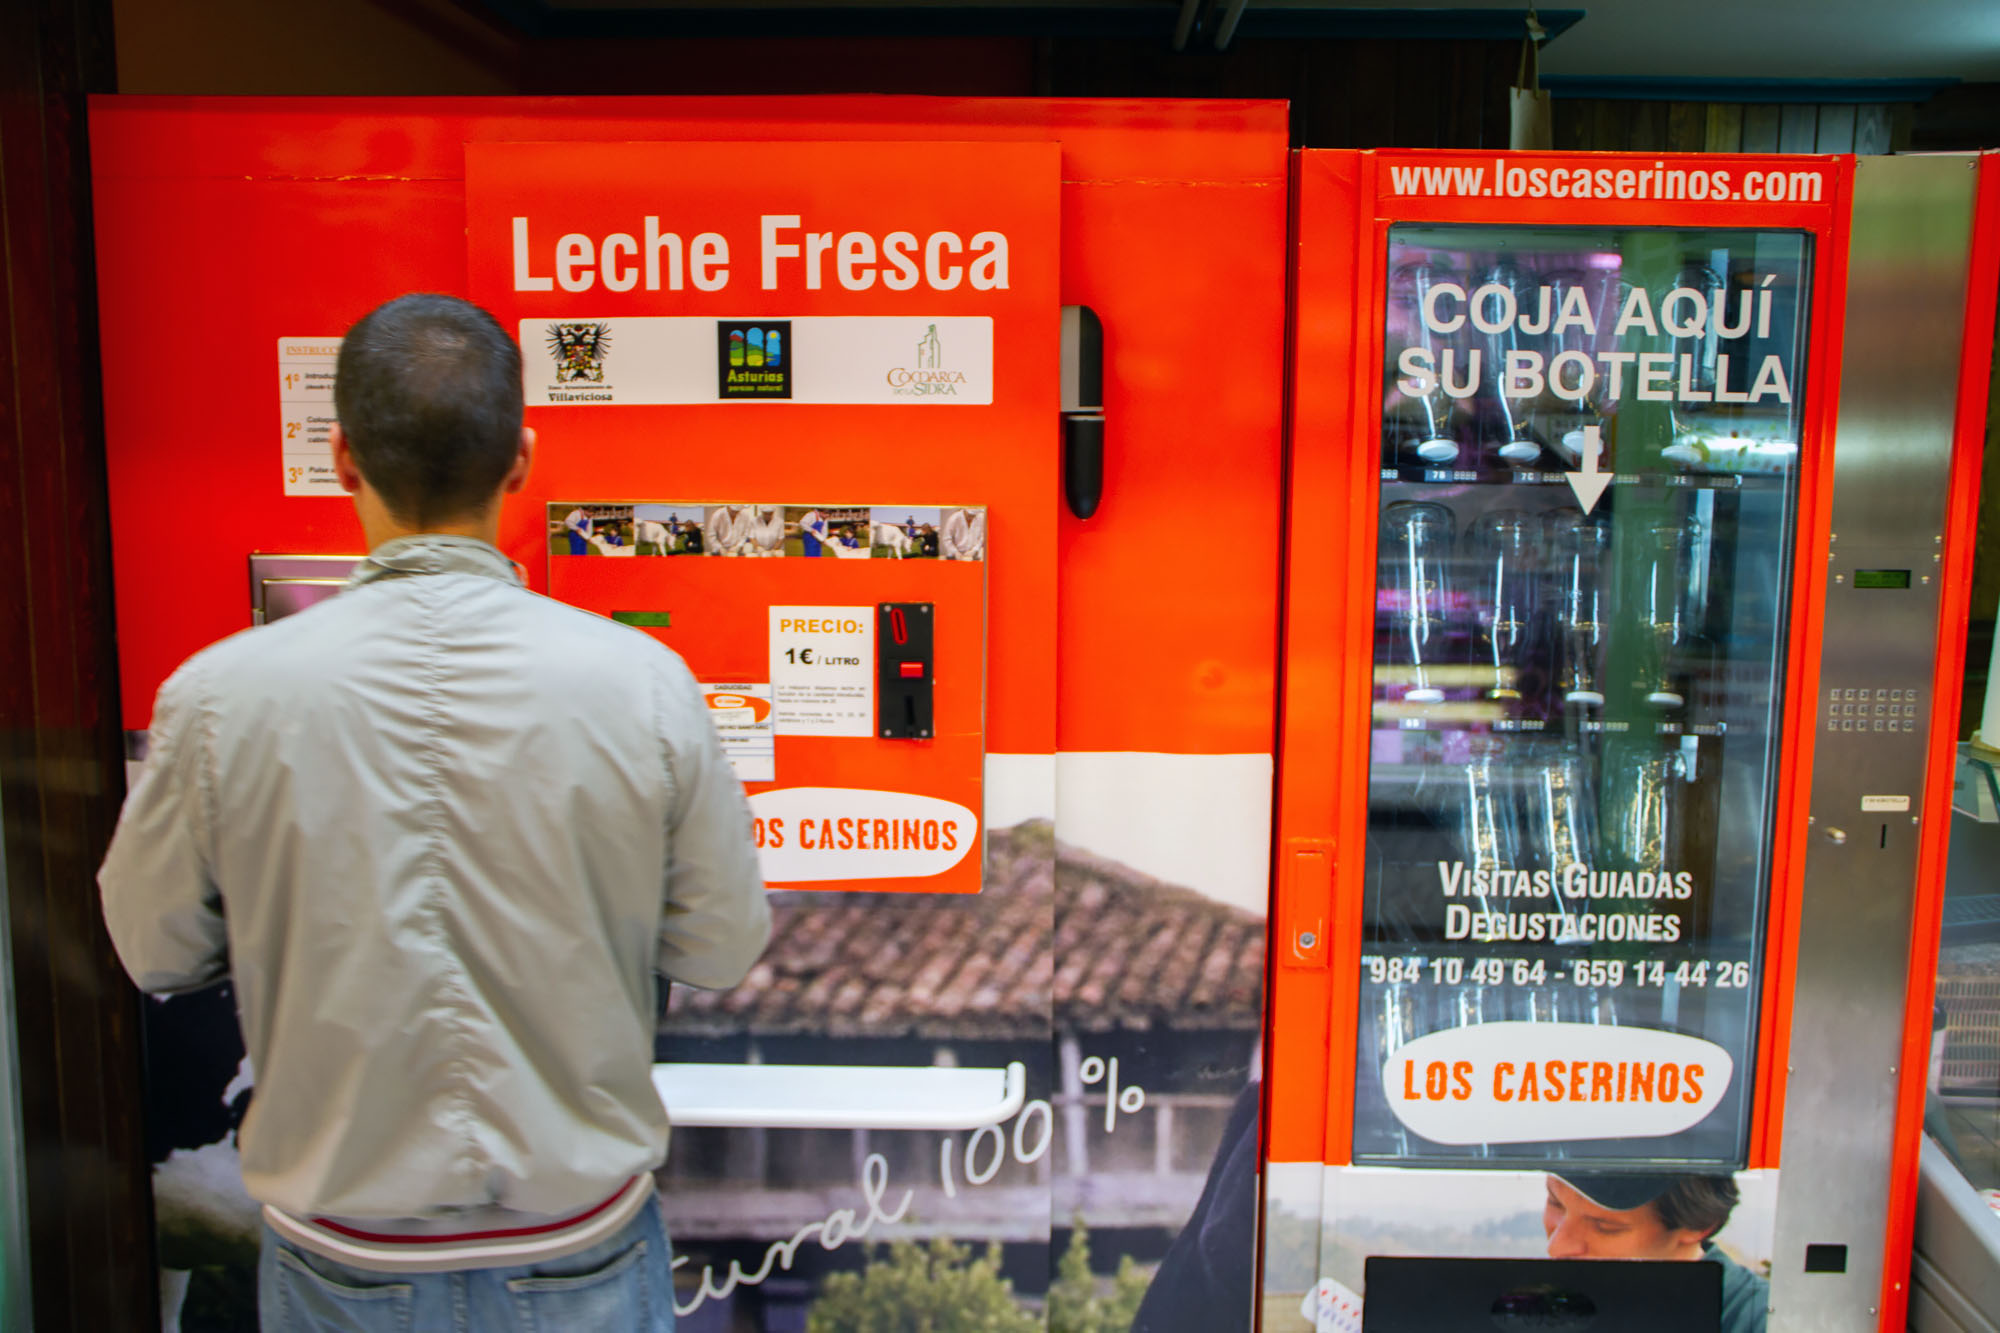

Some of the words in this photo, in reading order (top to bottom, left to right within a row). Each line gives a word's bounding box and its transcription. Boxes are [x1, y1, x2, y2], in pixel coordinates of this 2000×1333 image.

[1391, 158, 1823, 202] www.loscaserinos.com
[512, 215, 730, 293] Leche
[761, 214, 1010, 291] Fresca
[1424, 283, 1596, 336] COJA
[1614, 274, 1777, 340] AQUÍ
[286, 345, 342, 356] INSTRUCC
[728, 368, 784, 383] Asturias
[1398, 347, 1481, 399] SU
[1505, 349, 1792, 403] BOTELLA
[548, 392, 613, 402] Villaviciosa
[780, 618, 864, 634] PRECIO:
[785, 648, 814, 665] 1€
[825, 657, 860, 666] LITRO
[753, 818, 784, 848] OS
[799, 817, 958, 851] CASERINOS
[1438, 860, 1551, 899] VISITAS
[1563, 862, 1693, 900] GUIADAS
[1445, 904, 1682, 943] DEGUSTACIONES
[1369, 957, 1421, 984] 984
[1430, 958, 1463, 985] 10
[1471, 958, 1504, 986] 49
[1512, 959, 1546, 986] 64
[1573, 959, 1624, 987] 659
[1633, 960, 1665, 987] 14
[1674, 960, 1708, 988] 44
[1716, 961, 1749, 988] 26
[1403, 1060, 1473, 1101] LOS
[1493, 1061, 1705, 1104] CASERINOS
